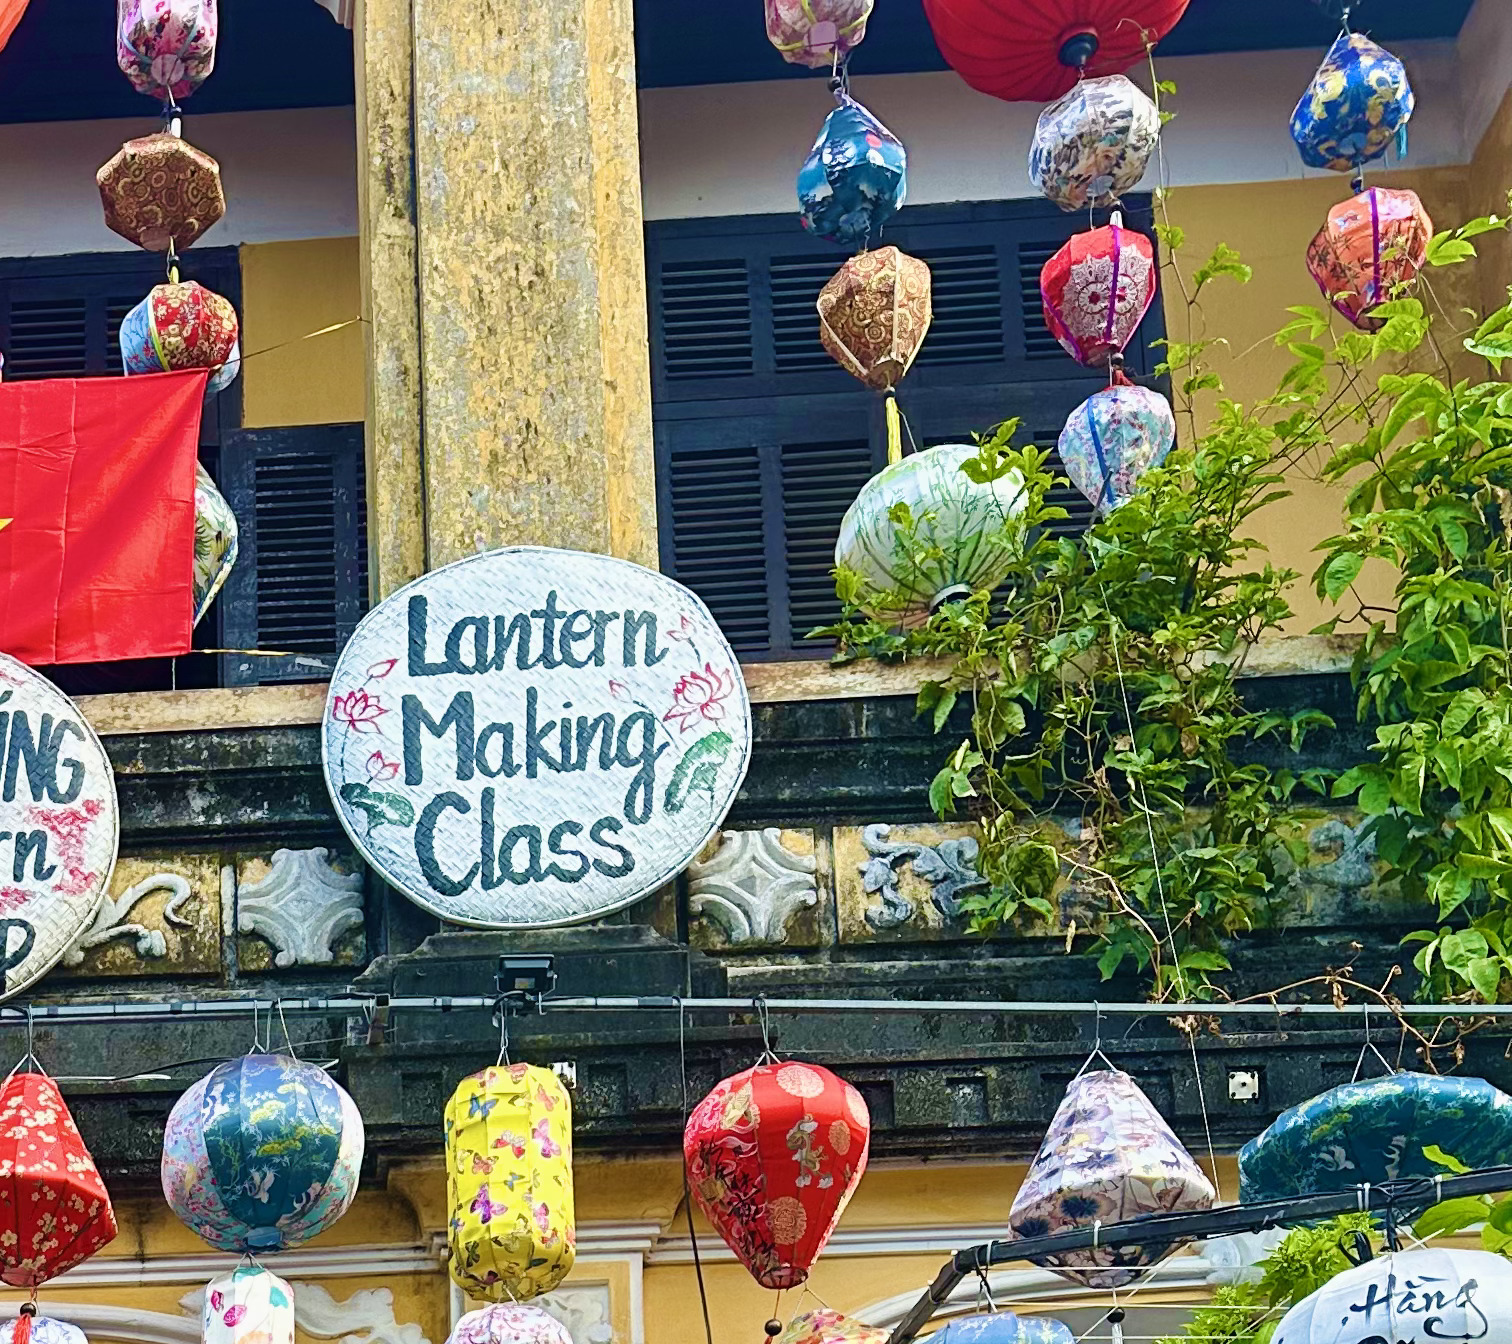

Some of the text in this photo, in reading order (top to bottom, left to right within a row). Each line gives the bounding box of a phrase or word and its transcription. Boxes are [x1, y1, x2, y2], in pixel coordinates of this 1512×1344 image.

[406, 589, 670, 677] Lantern
[401, 685, 670, 825] Making
[414, 786, 636, 897] Class
